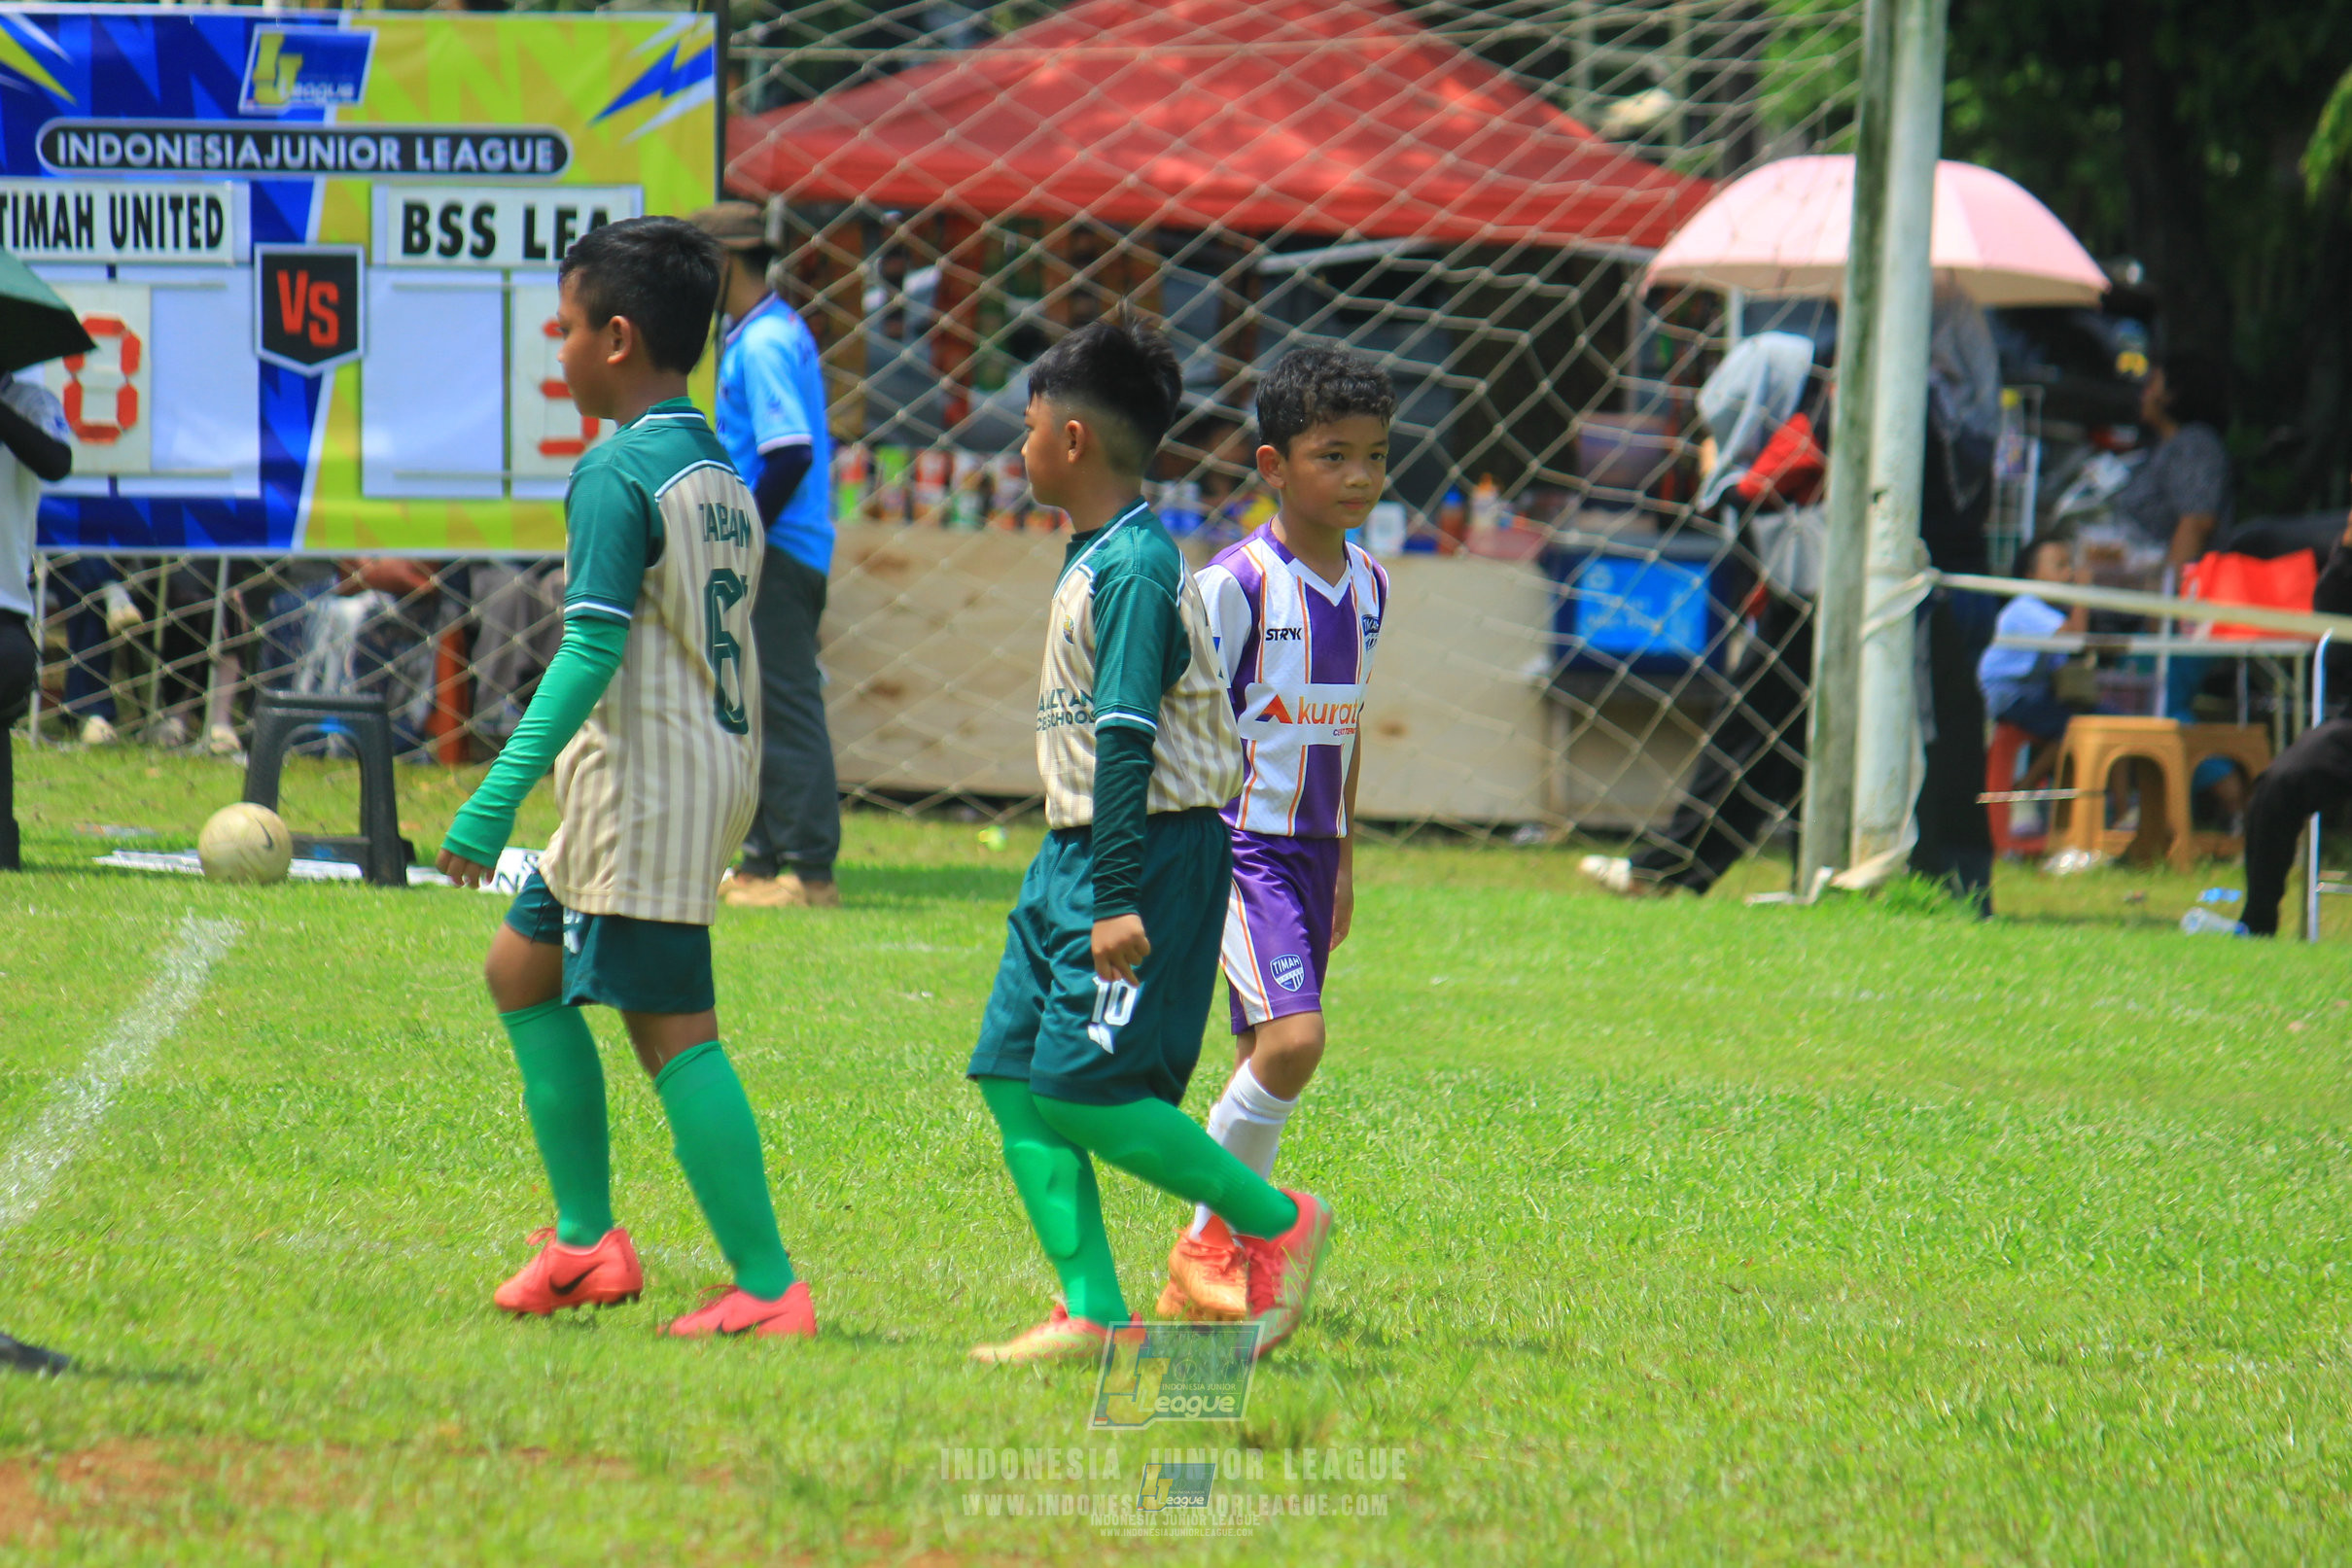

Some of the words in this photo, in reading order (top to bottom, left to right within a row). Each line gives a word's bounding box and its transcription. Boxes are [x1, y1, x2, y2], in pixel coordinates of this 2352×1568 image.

[414, 136, 554, 172] LEAGUE
[109, 192, 224, 250] UNITED
[402, 198, 497, 259] BSS
[276, 269, 339, 348] VS
[62, 314, 142, 445] 0
[704, 567, 749, 736] 6
[1265, 627, 1303, 643] STRYK
[1272, 957, 1301, 975] TIMAH
[1091, 975, 1141, 1027] 10
